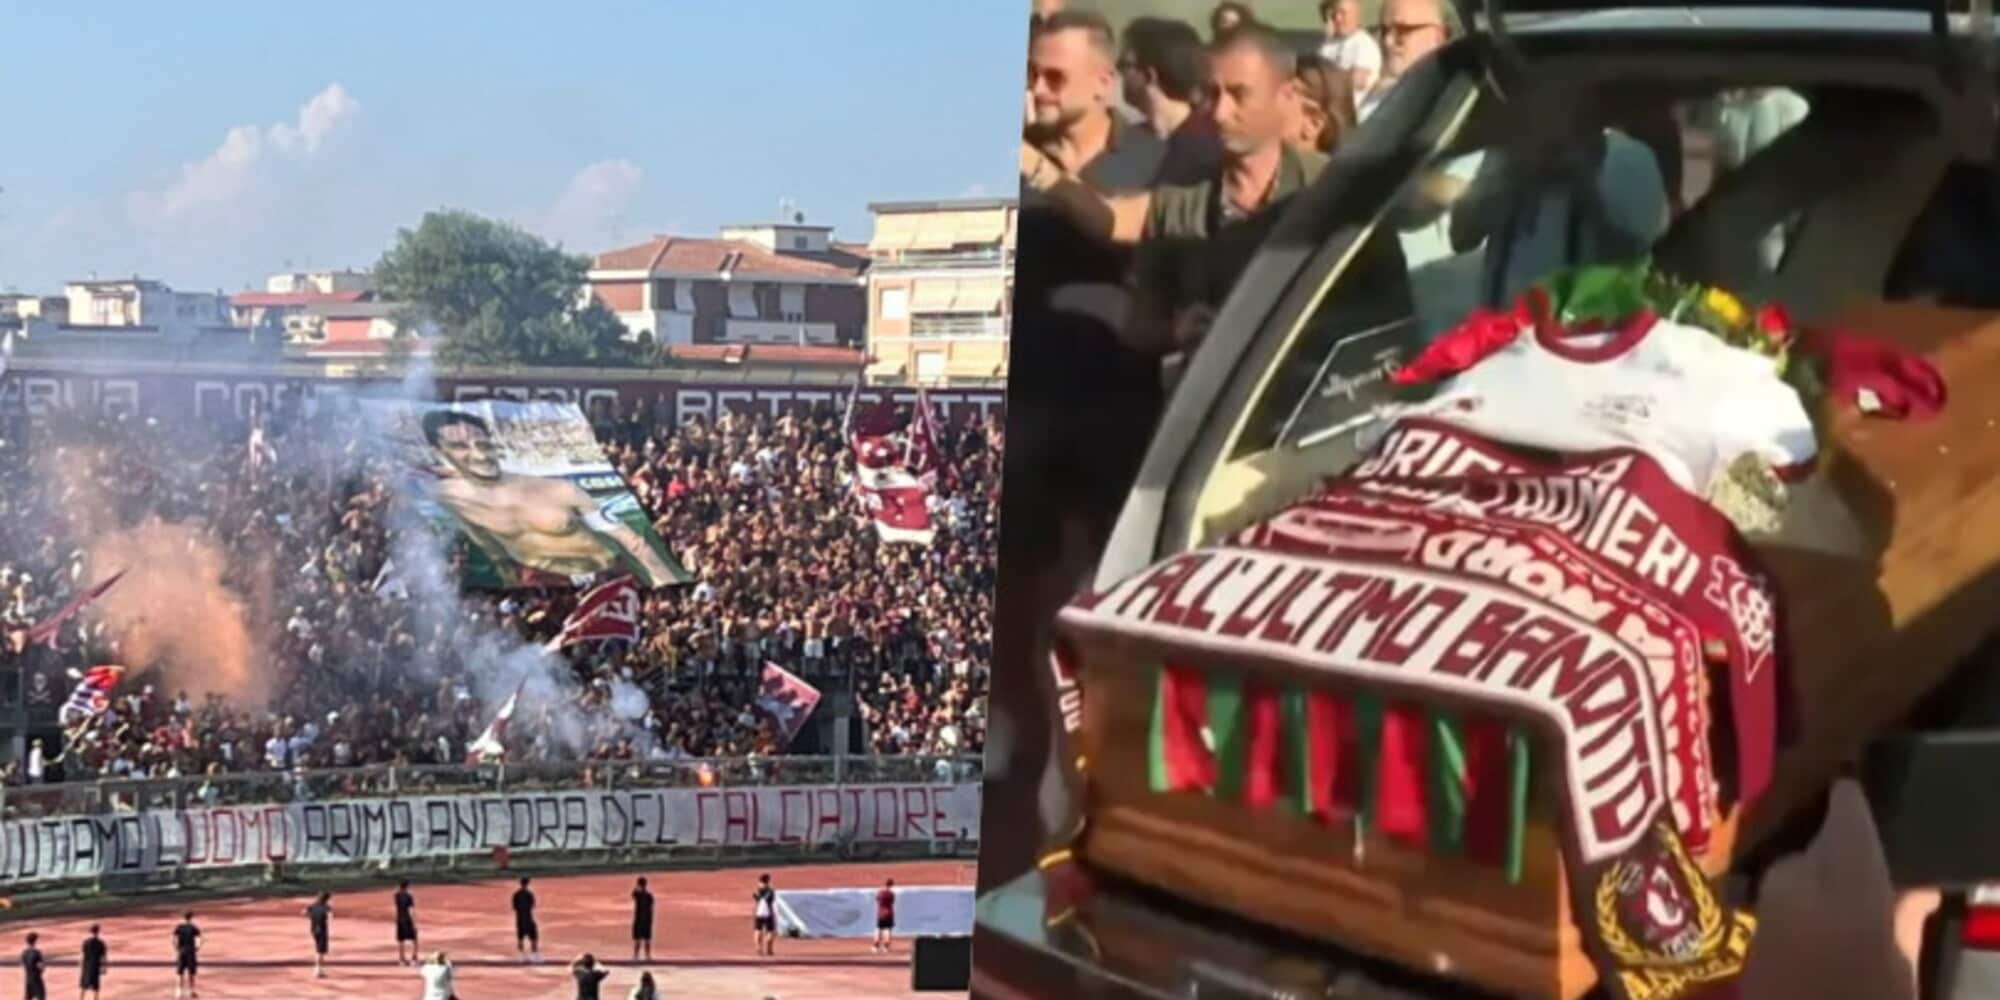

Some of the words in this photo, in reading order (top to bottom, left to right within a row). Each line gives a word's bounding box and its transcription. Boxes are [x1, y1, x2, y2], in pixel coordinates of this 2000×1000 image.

[1433, 599, 1657, 842] BANDITO
[303, 800, 412, 858] PRIMA
[426, 796, 587, 852] ANCORA
[601, 793, 679, 847] DEL
